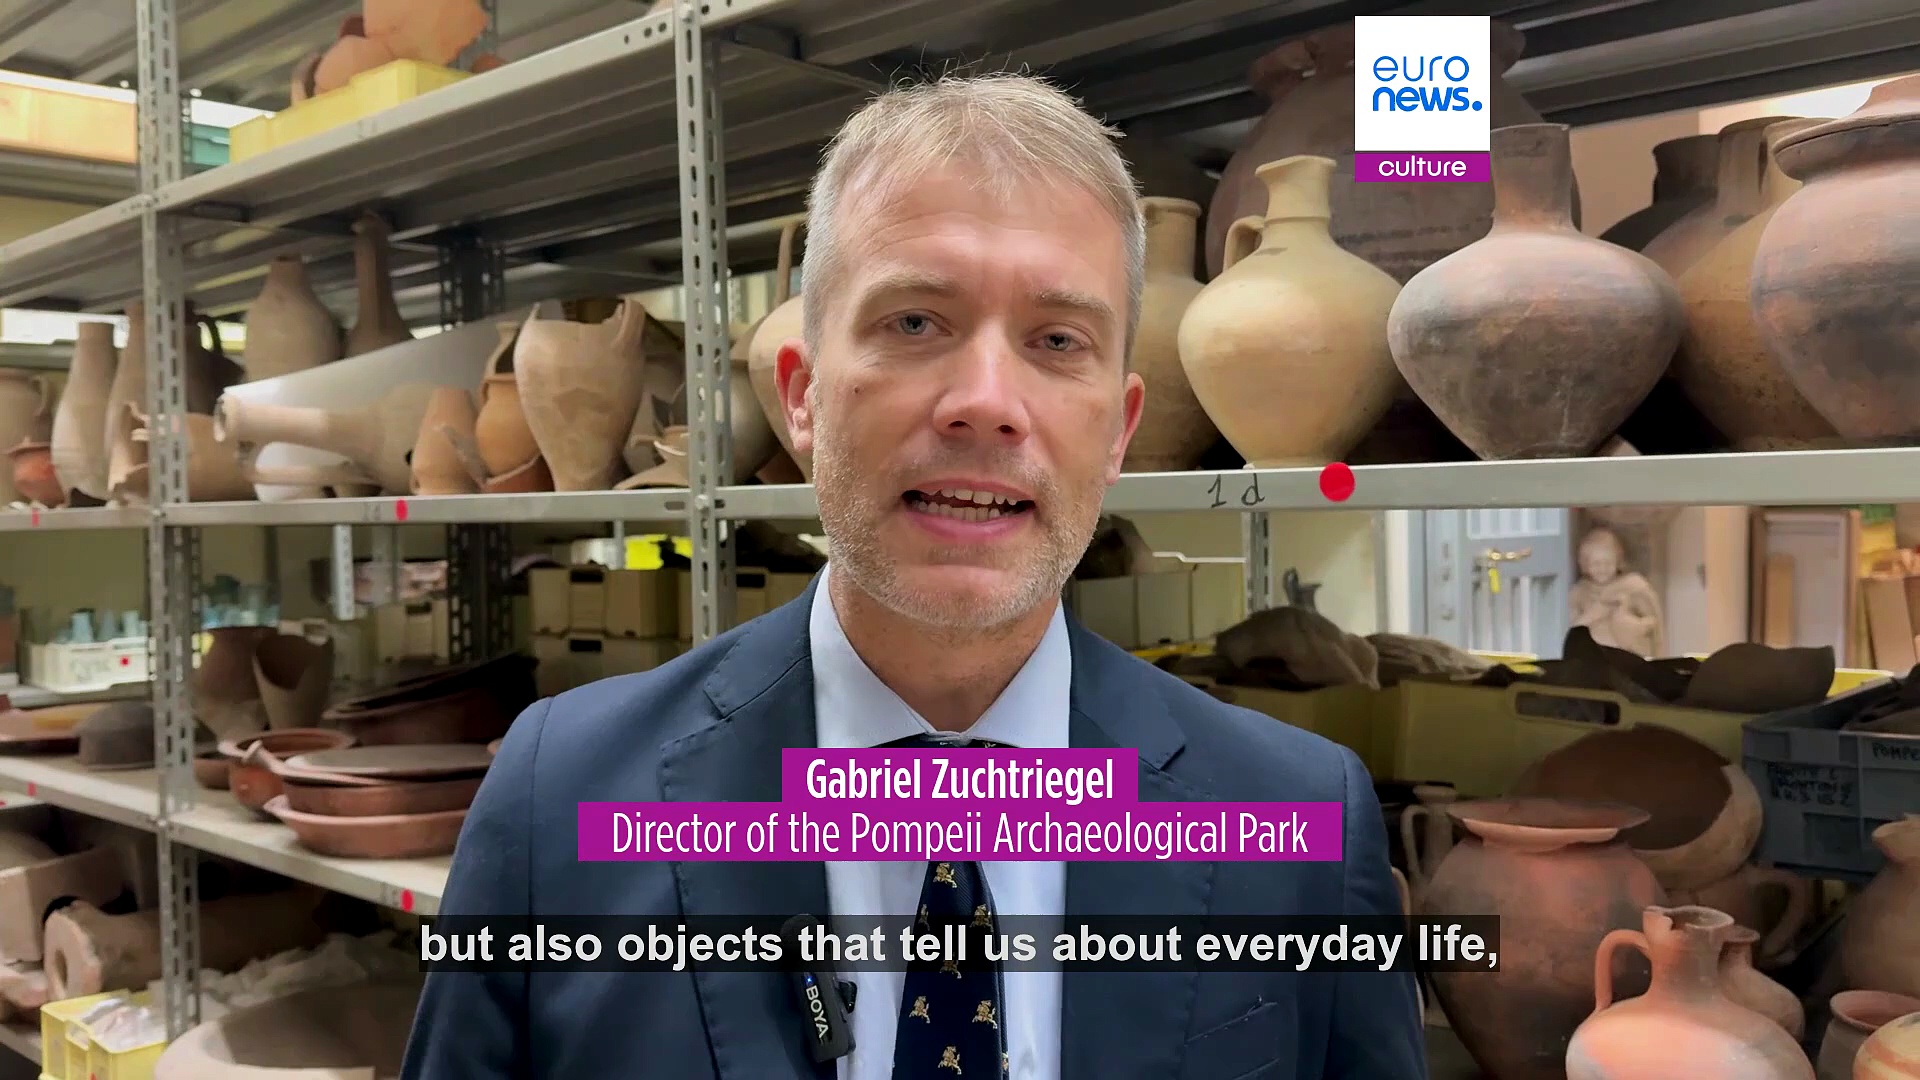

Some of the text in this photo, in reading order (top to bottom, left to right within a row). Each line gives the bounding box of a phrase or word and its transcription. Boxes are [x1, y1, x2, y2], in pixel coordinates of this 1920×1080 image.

[1207, 472, 1265, 508] 1 d
[805, 985, 829, 1039] BOYA
